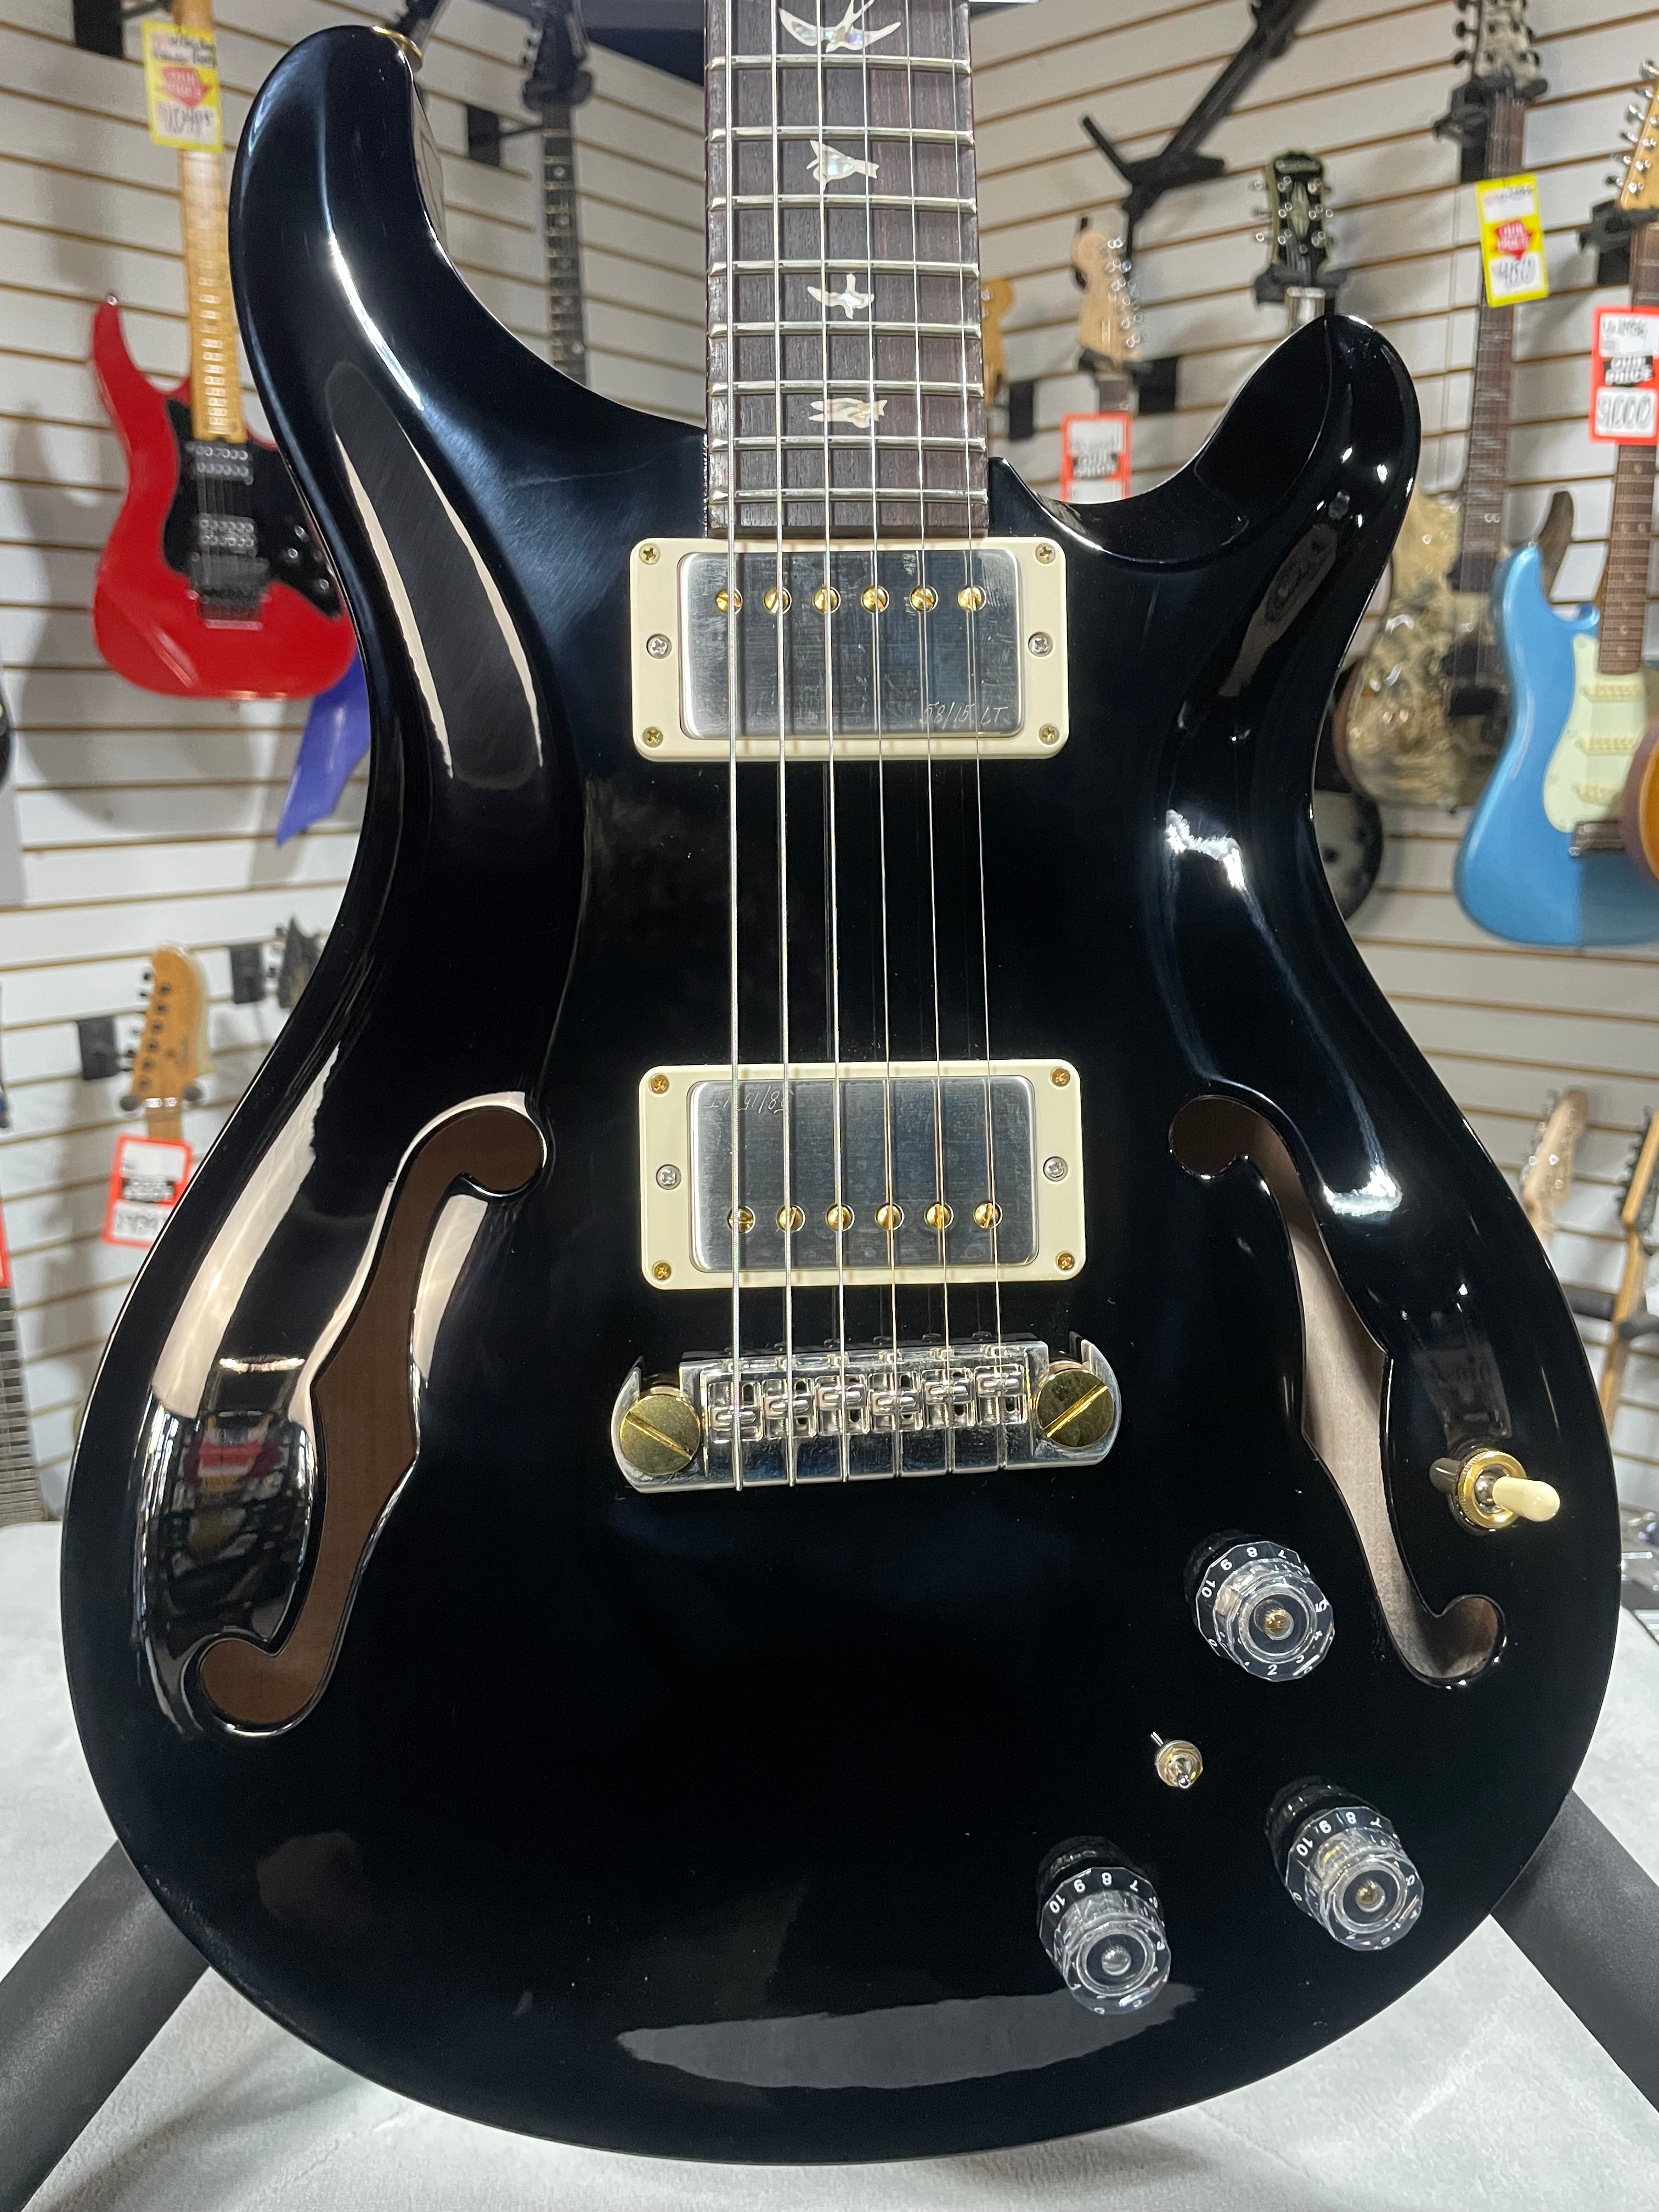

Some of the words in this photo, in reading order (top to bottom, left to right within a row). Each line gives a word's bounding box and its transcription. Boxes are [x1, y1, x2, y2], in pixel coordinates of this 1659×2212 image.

[980, 706, 1008, 725] LT
[1201, 1579, 1216, 1598] 10
[1220, 1559, 1232, 1571] 9
[1246, 1547, 1258, 1558] 8
[1278, 1550, 1286, 1559] 7
[1267, 1664, 1277, 1675] 2
[1296, 1837, 1313, 1857] 10
[1318, 1820, 1331, 1833] 9
[1346, 1812, 1357, 1824] 8
[1049, 1894, 1065, 1914] 10
[1073, 1879, 1086, 1892] 9
[1102, 1872, 1112, 1885] 8
[1130, 1880, 1138, 1892] 7
